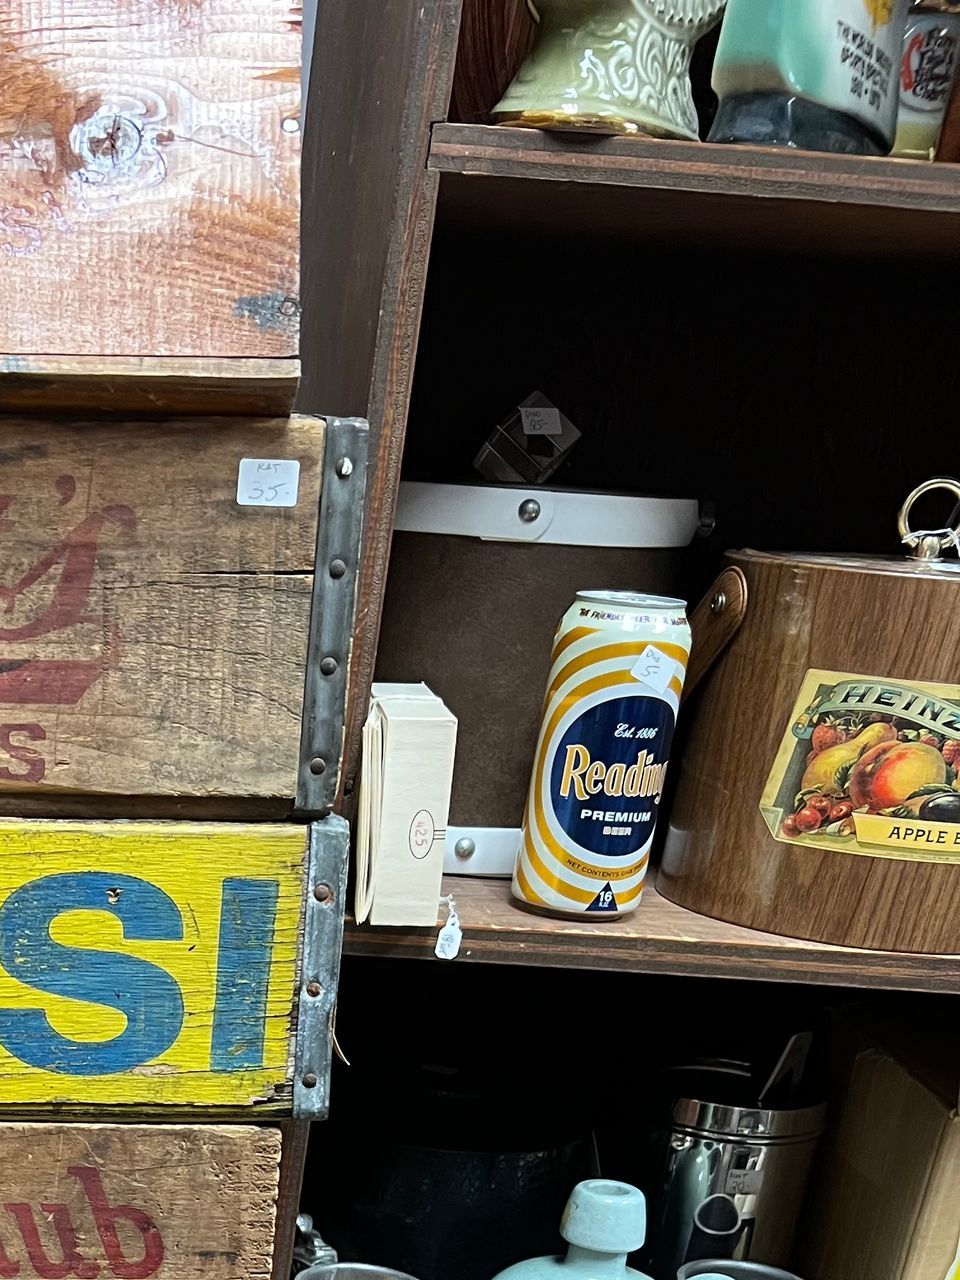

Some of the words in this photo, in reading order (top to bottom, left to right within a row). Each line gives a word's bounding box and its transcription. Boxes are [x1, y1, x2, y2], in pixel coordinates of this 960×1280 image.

[559, 744, 669, 805] Reading
[580, 808, 652, 823] PREMIUM
[602, 826, 633, 836] BEER
[888, 826, 948, 844] APPLE
[566, 858, 581, 870] NET
[581, 866, 620, 878] CONTENTS
[598, 890, 614, 903] 16
